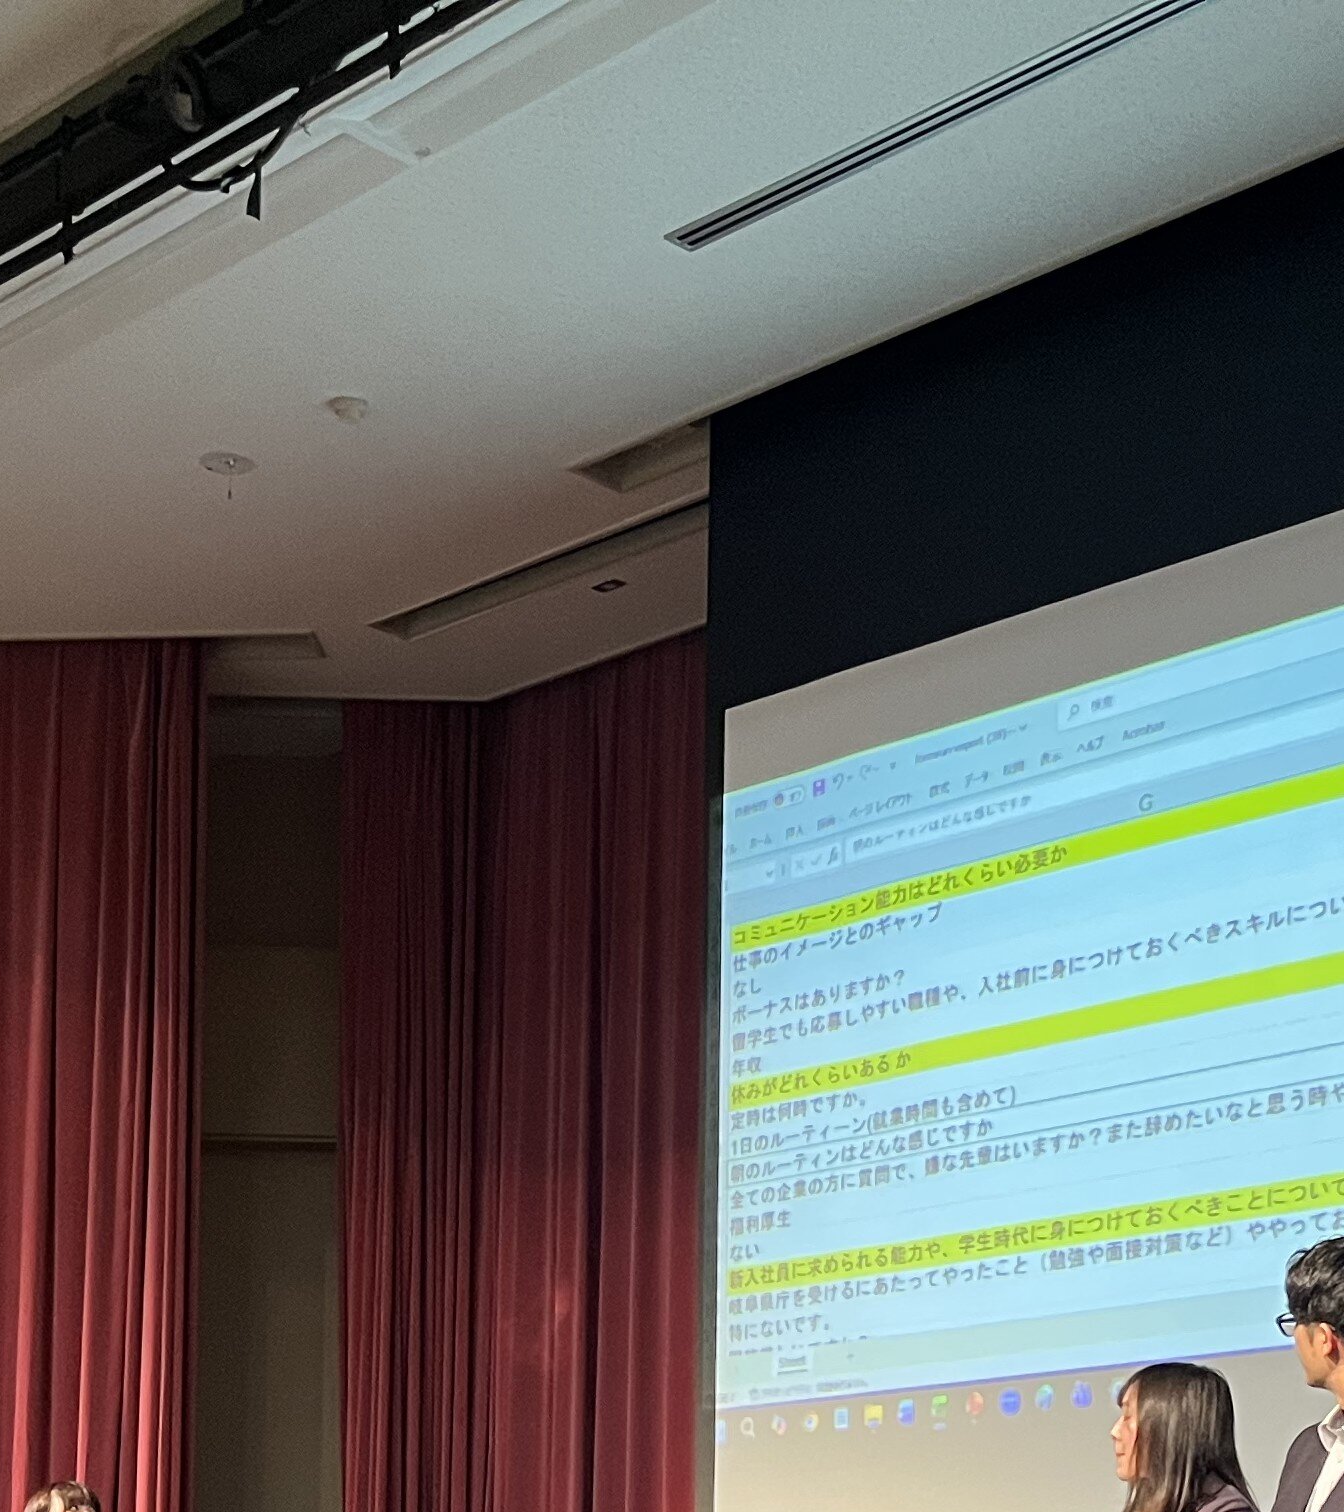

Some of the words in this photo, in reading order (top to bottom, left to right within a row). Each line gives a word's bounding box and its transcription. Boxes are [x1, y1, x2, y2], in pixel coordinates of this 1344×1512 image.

[1138, 792, 1154, 813] G
[734, 845, 1067, 944] コミュニケーション能力はどれくらい必要か
[732, 901, 942, 973] 仕事のイメージとのギャップ
[733, 977, 761, 998] なし
[732, 1056, 761, 1077] 年収
[730, 1091, 865, 1131] 定時は何時ですか。
[731, 1118, 993, 1181] 朝のルーティンはどんな感じですか
[730, 1209, 790, 1235] 福利厚生
[730, 1243, 759, 1261] ない
